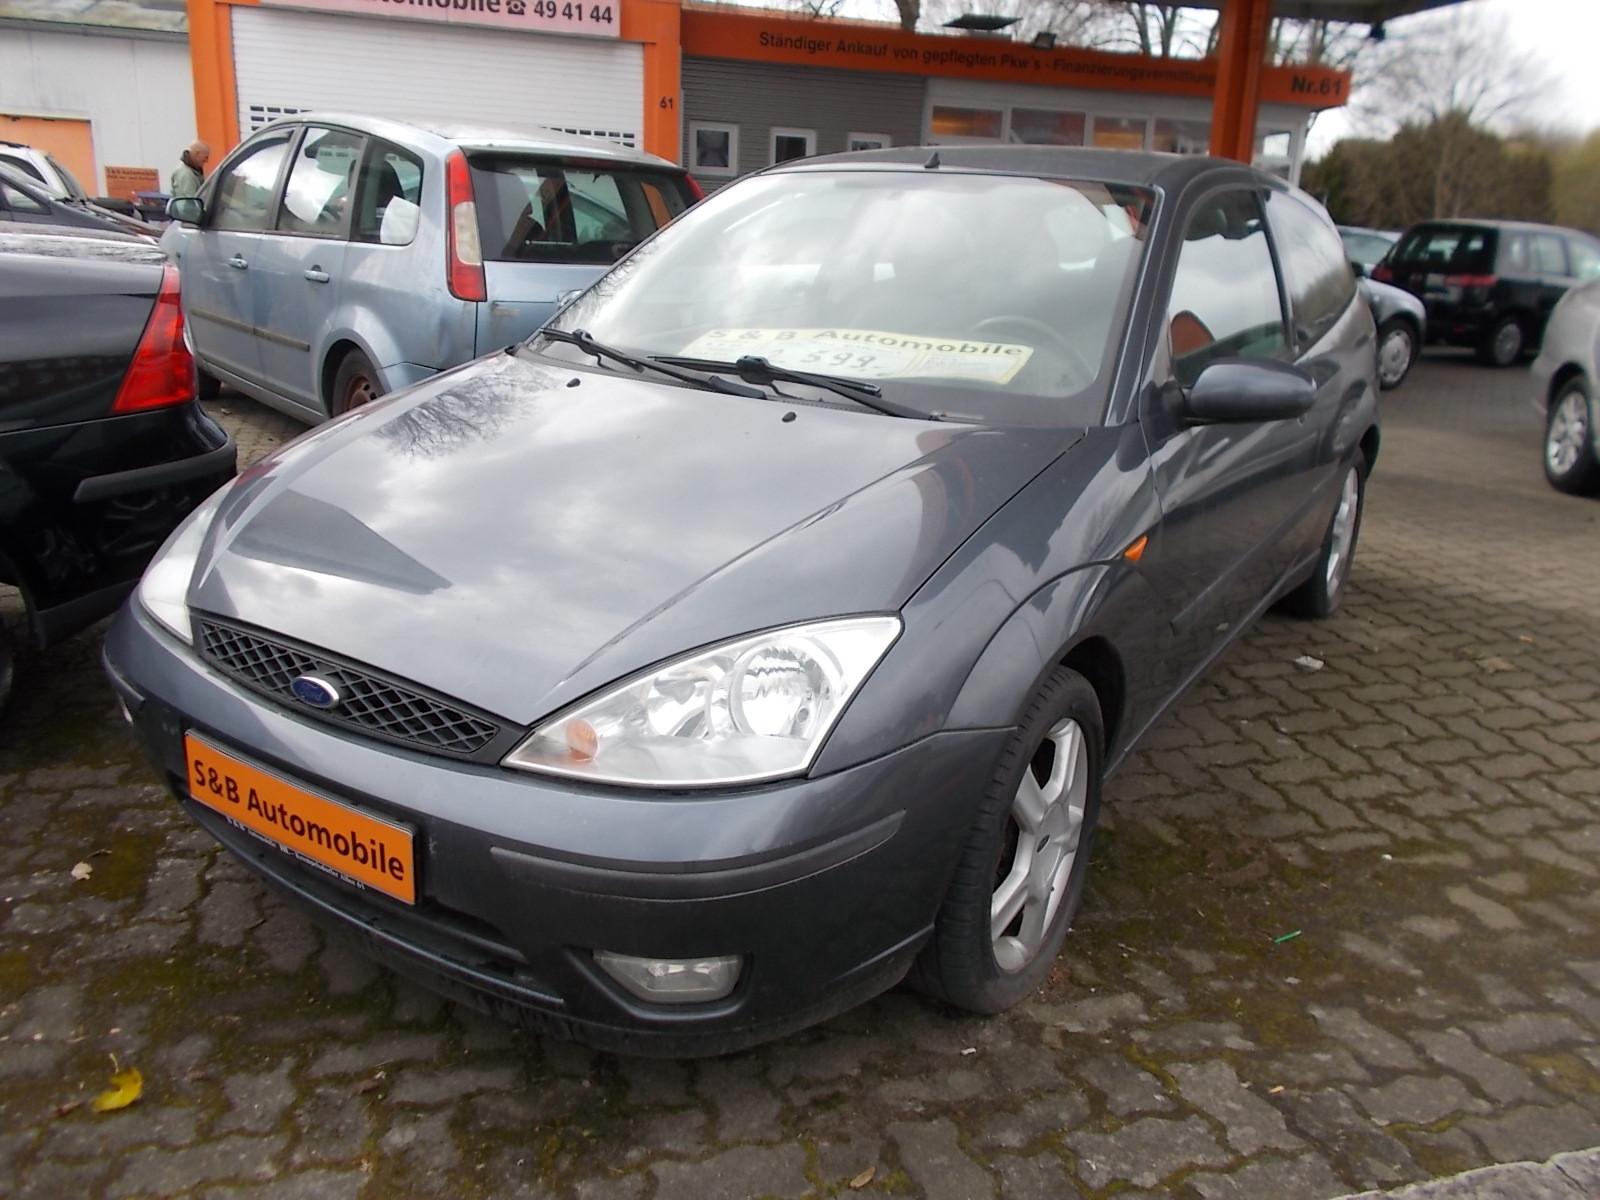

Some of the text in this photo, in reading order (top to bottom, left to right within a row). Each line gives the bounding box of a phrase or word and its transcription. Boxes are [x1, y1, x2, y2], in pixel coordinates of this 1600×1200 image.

[534, 0, 557, 18] 49
[562, 3, 584, 21] 41
[589, 5, 613, 24] 44
[759, 31, 831, 54] Ständiger
[836, 39, 888, 58] Ankauf
[893, 48, 919, 60] von
[922, 49, 997, 66] gepflegten
[659, 95, 673, 110] 61
[813, 330, 1022, 355] Automobile
[194, 759, 240, 804] S&B
[247, 788, 405, 881] Automobile
